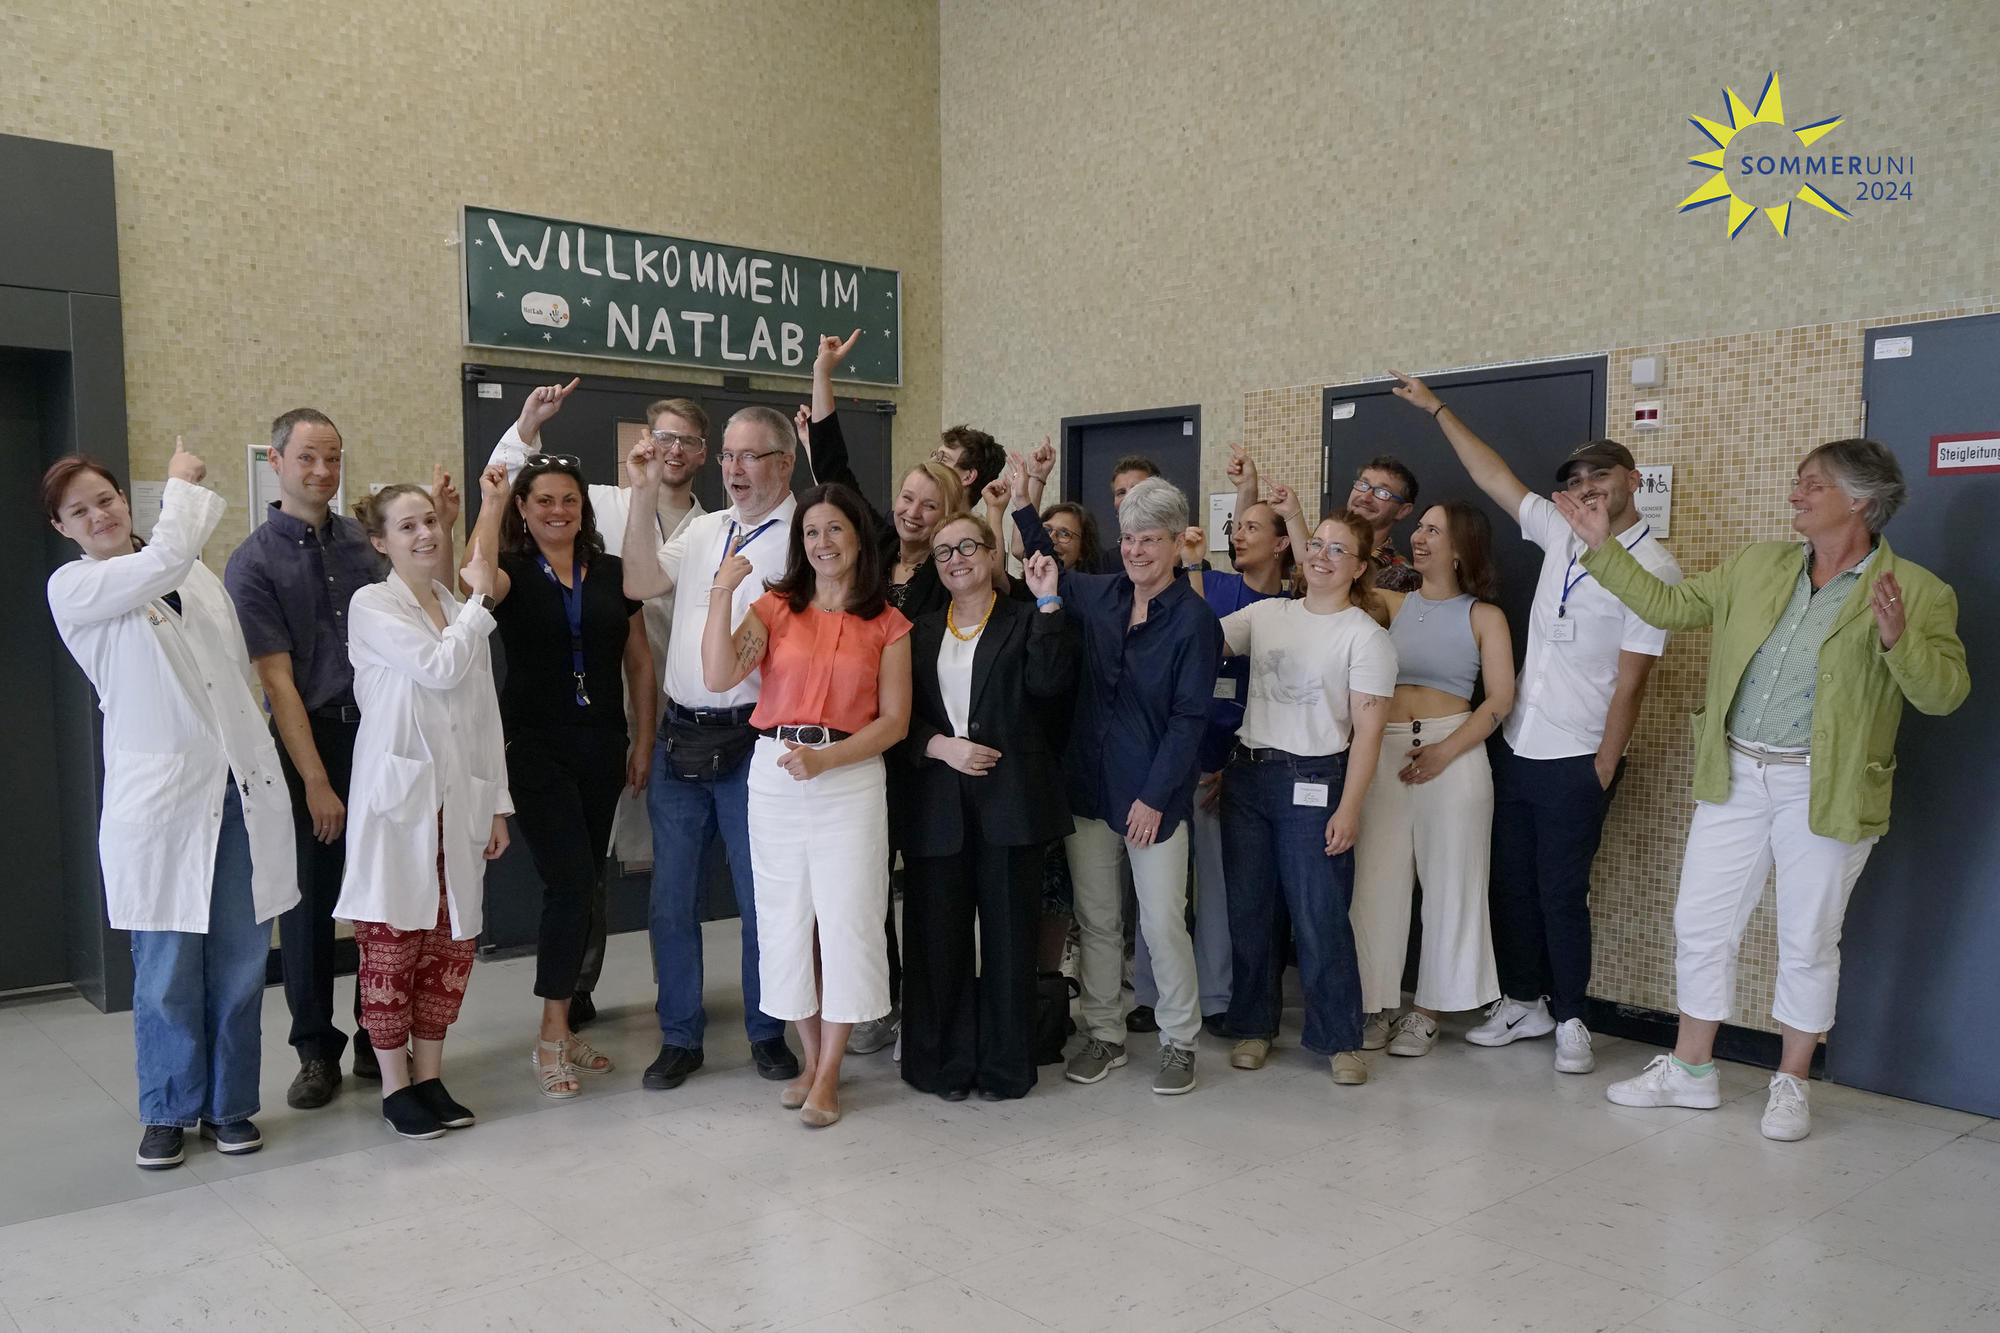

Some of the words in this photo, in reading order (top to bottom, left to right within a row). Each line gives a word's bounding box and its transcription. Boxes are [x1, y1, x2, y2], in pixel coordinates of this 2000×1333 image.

[487, 218, 799, 306] WILLKOMMEN
[820, 268, 858, 313] IM
[606, 300, 805, 367] NATLAB
